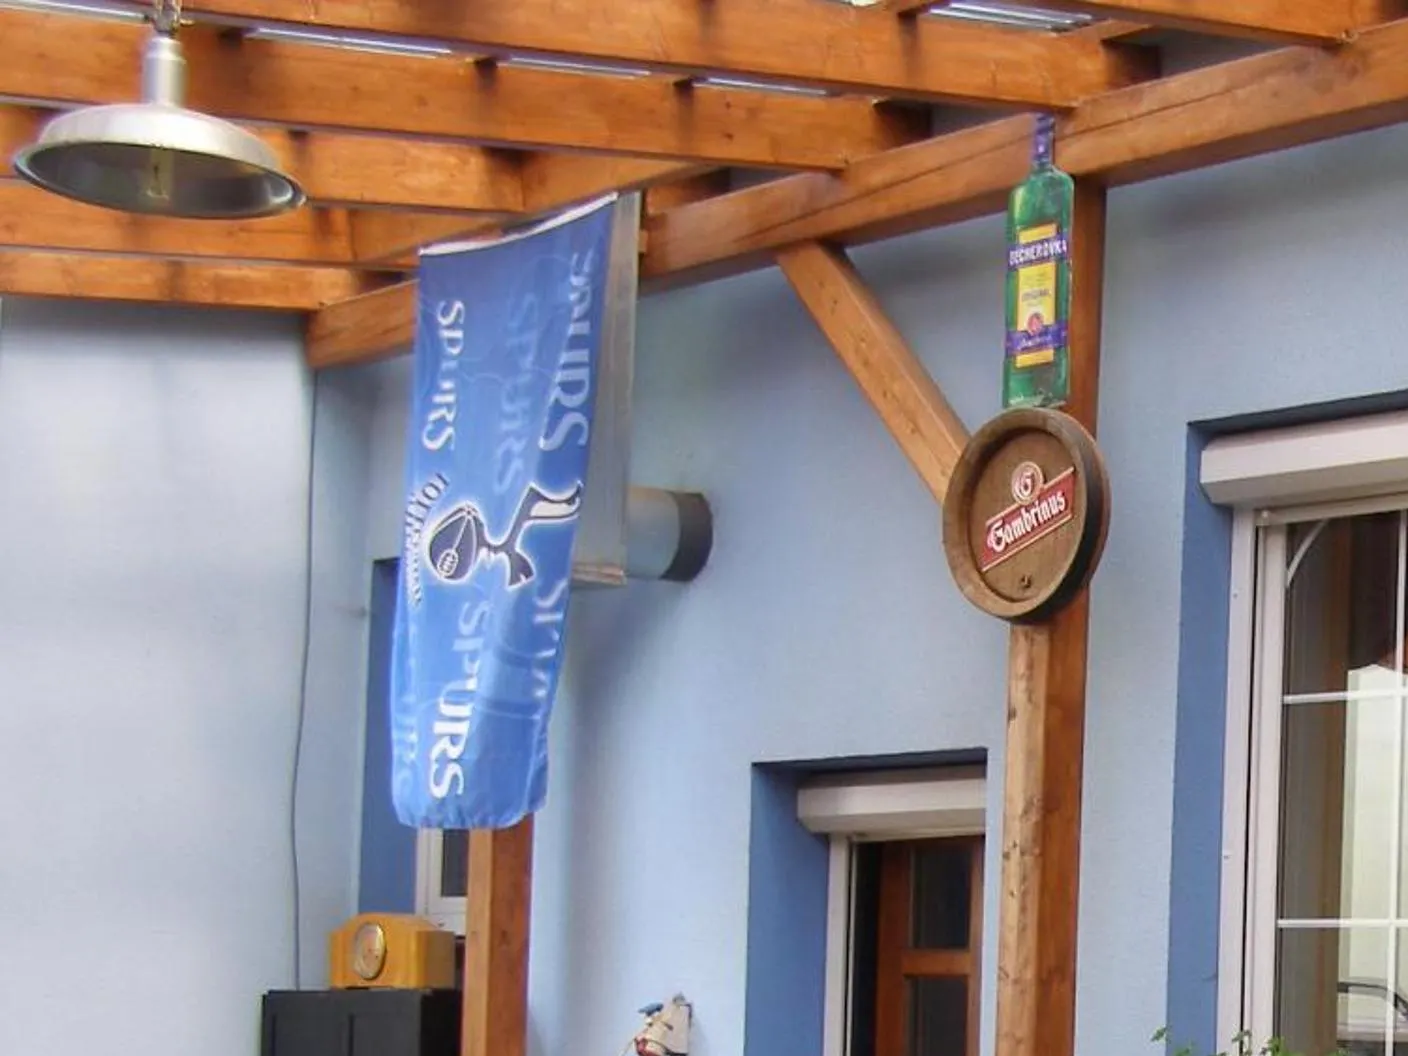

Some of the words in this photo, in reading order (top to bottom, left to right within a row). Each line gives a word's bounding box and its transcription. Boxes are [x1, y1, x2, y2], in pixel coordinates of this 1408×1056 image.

[421, 300, 466, 451] SPURS
[986, 490, 1066, 553] Gambrinus
[428, 600, 494, 799] SPURS
